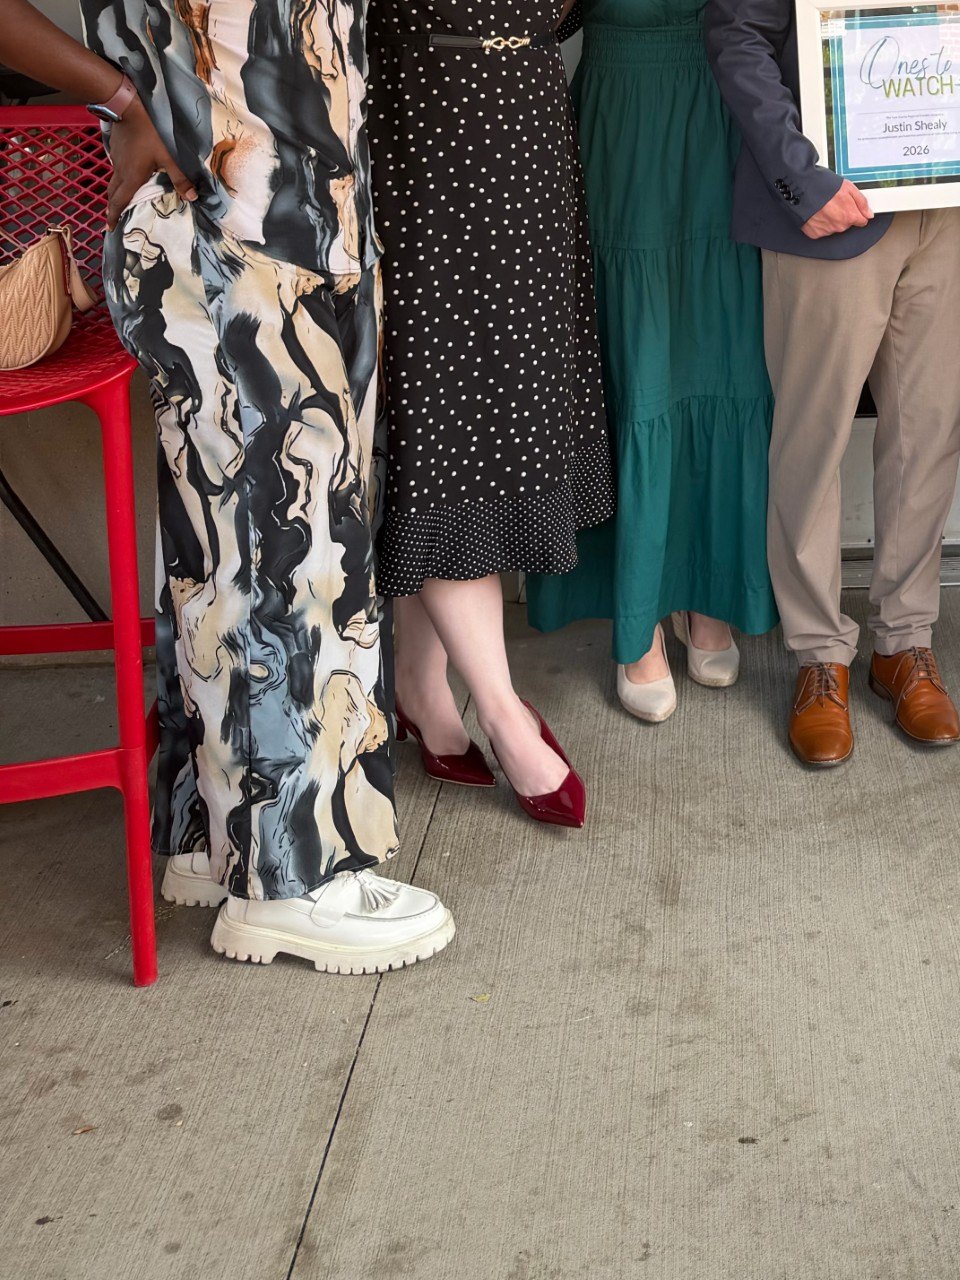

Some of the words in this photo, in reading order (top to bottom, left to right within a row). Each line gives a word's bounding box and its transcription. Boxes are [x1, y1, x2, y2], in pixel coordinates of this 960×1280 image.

[859, 35, 931, 89] Ones
[930, 45, 952, 76] to
[882, 75, 954, 99] WATCH
[883, 121, 912, 133] Justin
[915, 119, 948, 132] Shealy
[903, 145, 930, 157] 2026
